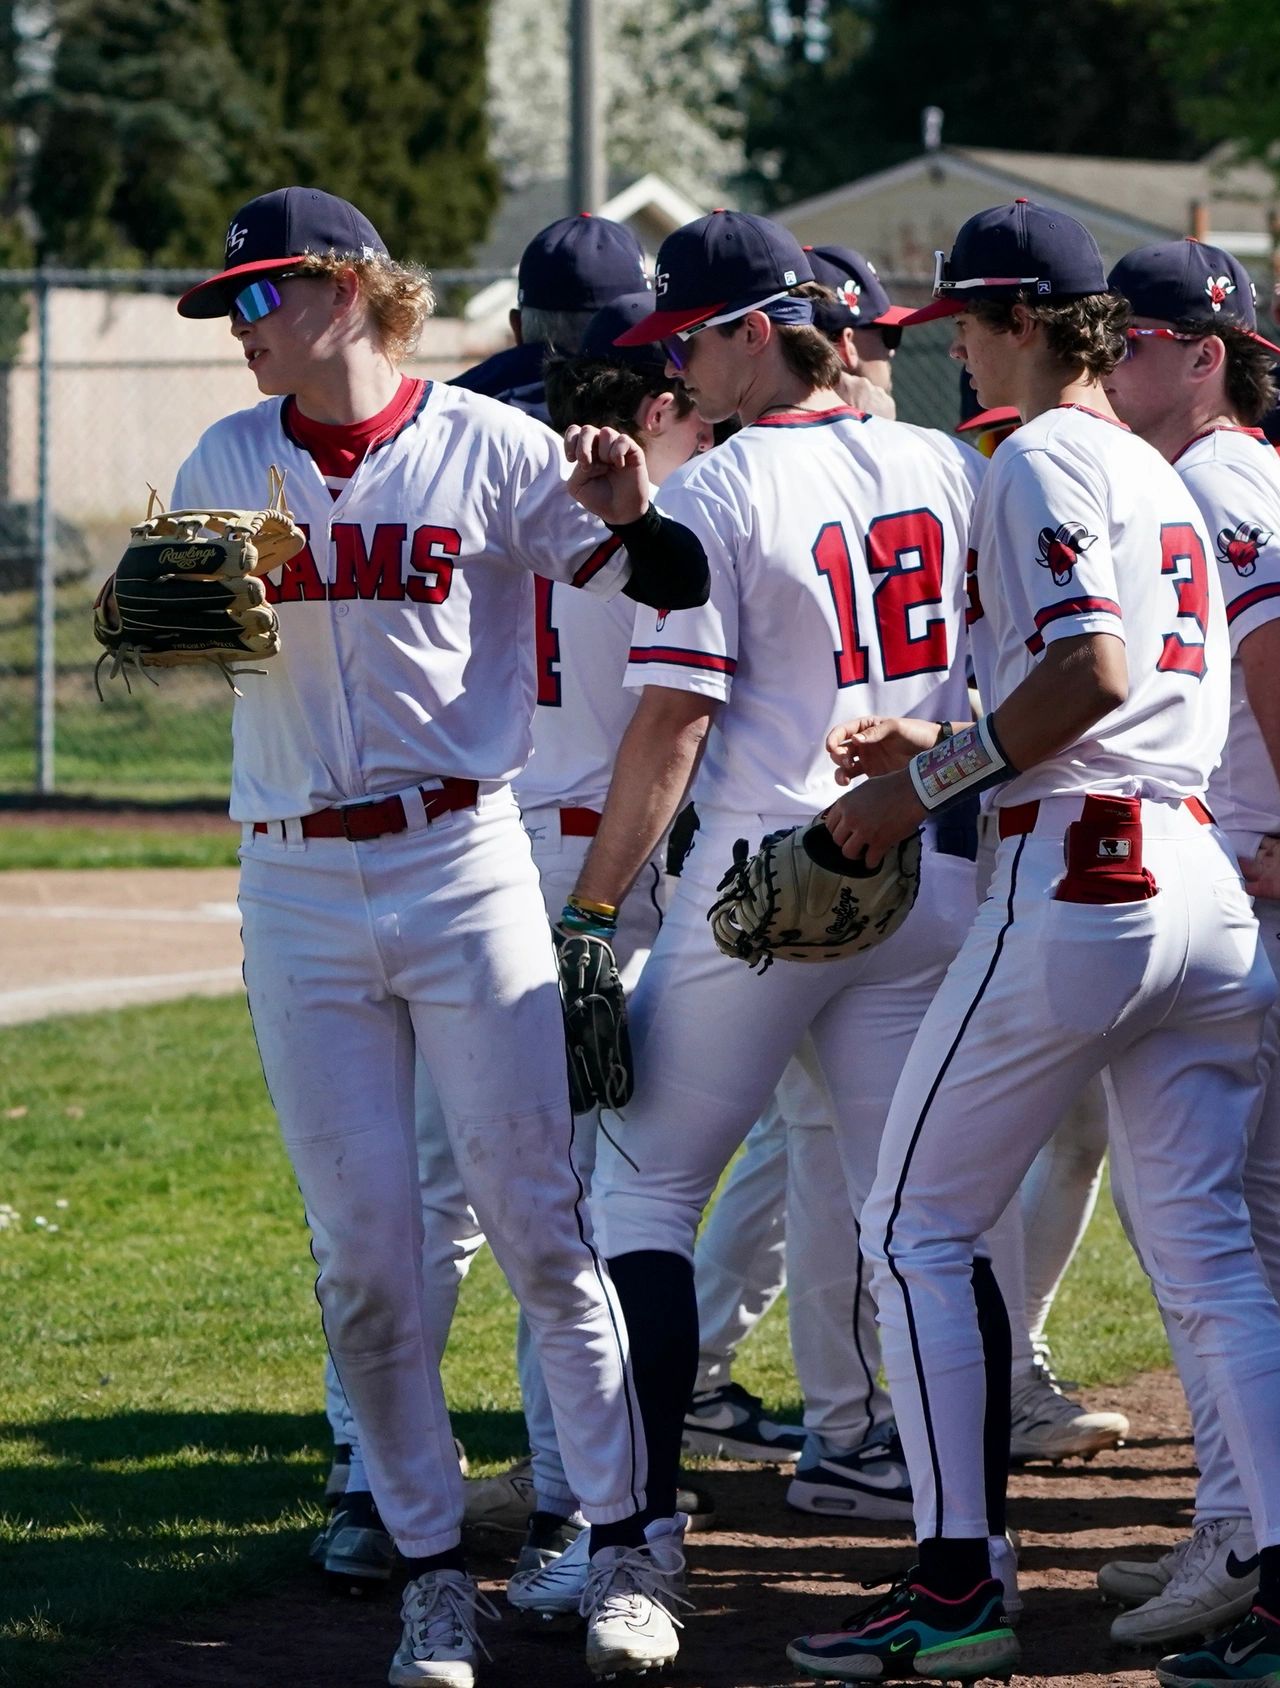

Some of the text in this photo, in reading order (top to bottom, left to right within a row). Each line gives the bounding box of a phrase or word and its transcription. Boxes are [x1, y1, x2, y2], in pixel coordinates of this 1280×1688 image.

[158, 545, 217, 565] Rawlings
[811, 507, 949, 689] 12
[1155, 522, 1209, 682] 3
